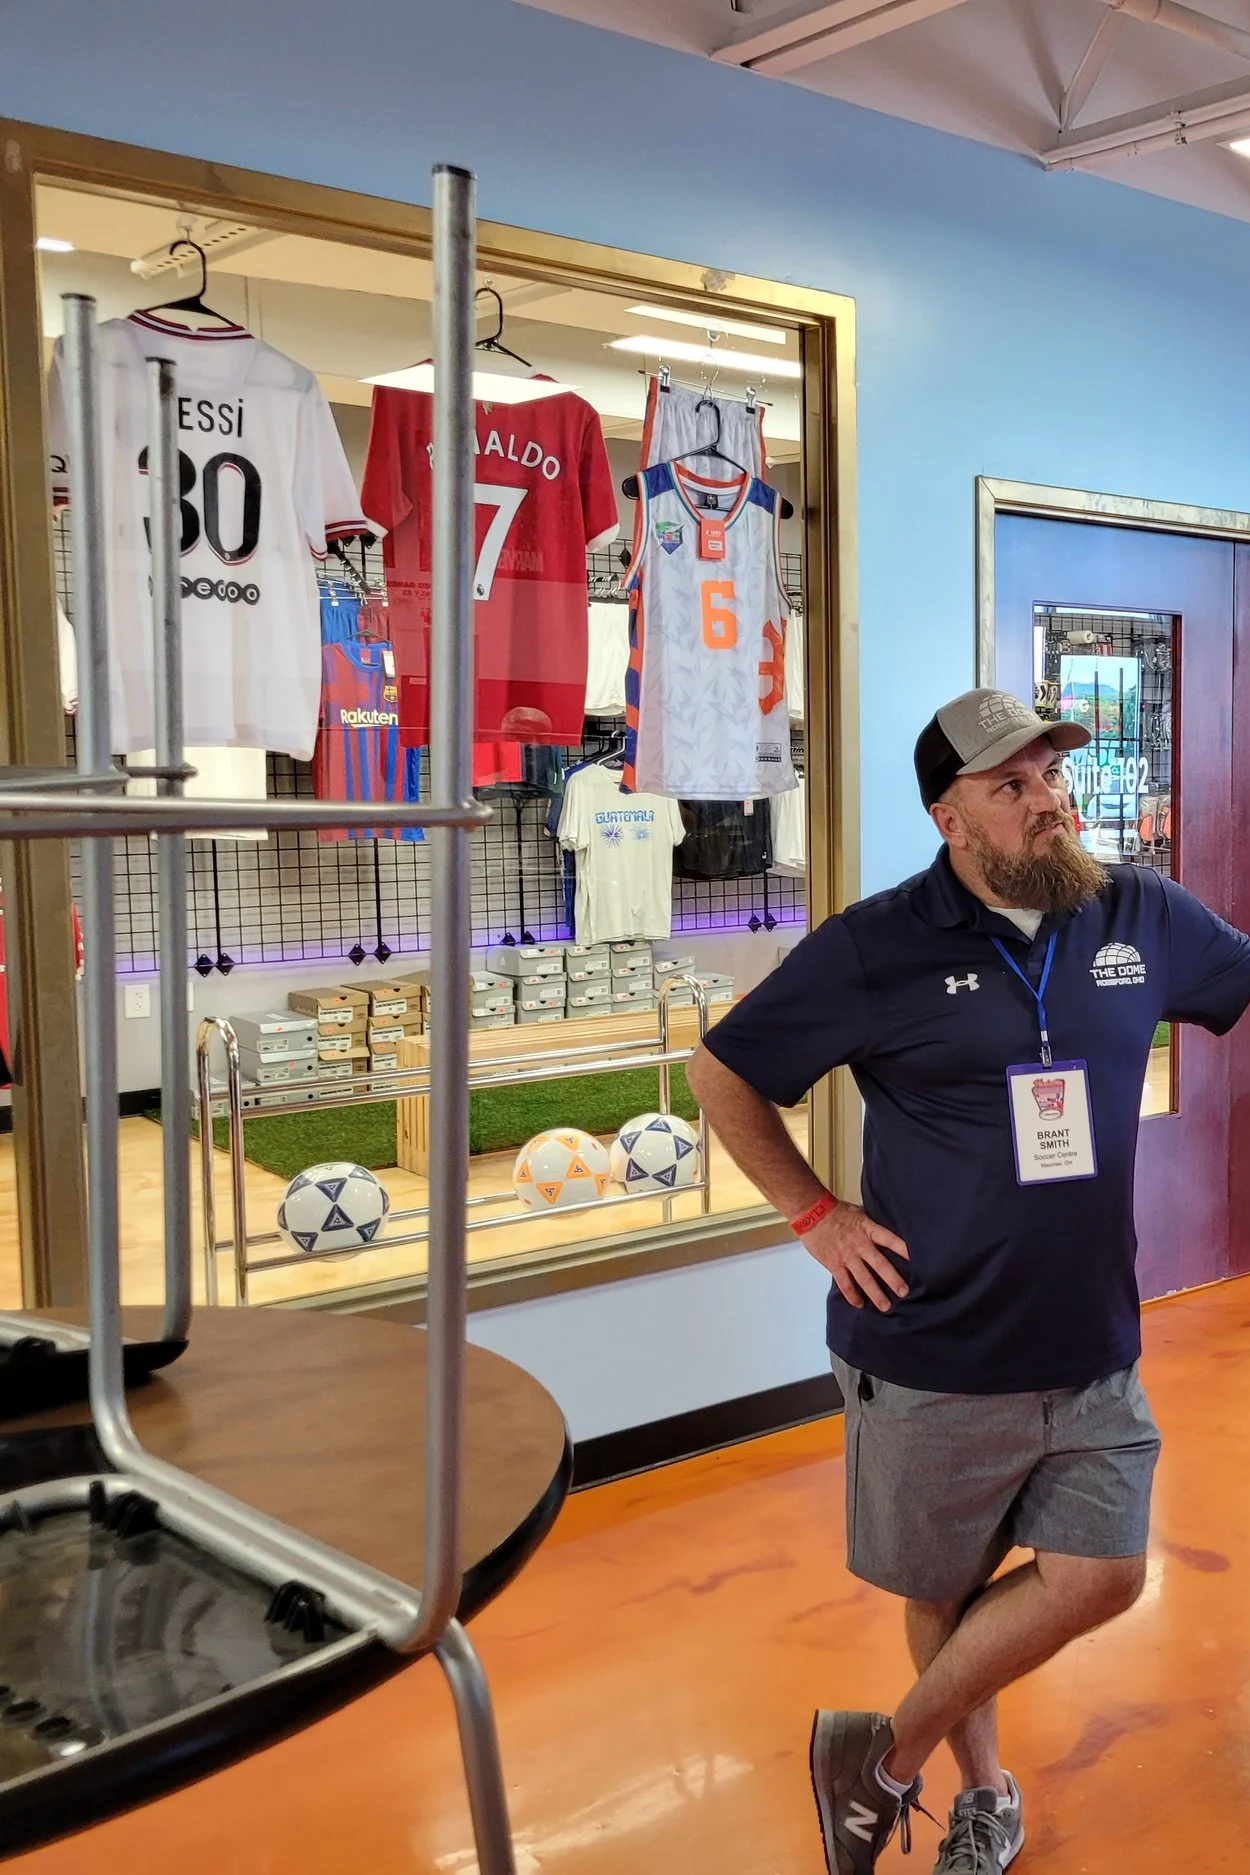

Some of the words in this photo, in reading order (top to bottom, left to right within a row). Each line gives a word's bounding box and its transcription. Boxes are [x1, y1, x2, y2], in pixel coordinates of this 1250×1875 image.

[177, 396, 244, 438] ESSi
[473, 482, 529, 601] 7
[700, 580, 738, 651] 6
[340, 708, 399, 728] Rakuten
[978, 711, 1008, 729] THE
[1062, 756, 1112, 795] Suite
[1119, 756, 1149, 794] 102
[595, 809, 655, 825] GUATEMALA
[1089, 968, 1117, 979] THE
[1117, 964, 1147, 976] DOME
[1037, 1128, 1070, 1140] BRANT
[1040, 1139, 1070, 1150] SMITH
[1033, 1153, 1056, 1161] Soccer
[843, 1801, 878, 1842] N
